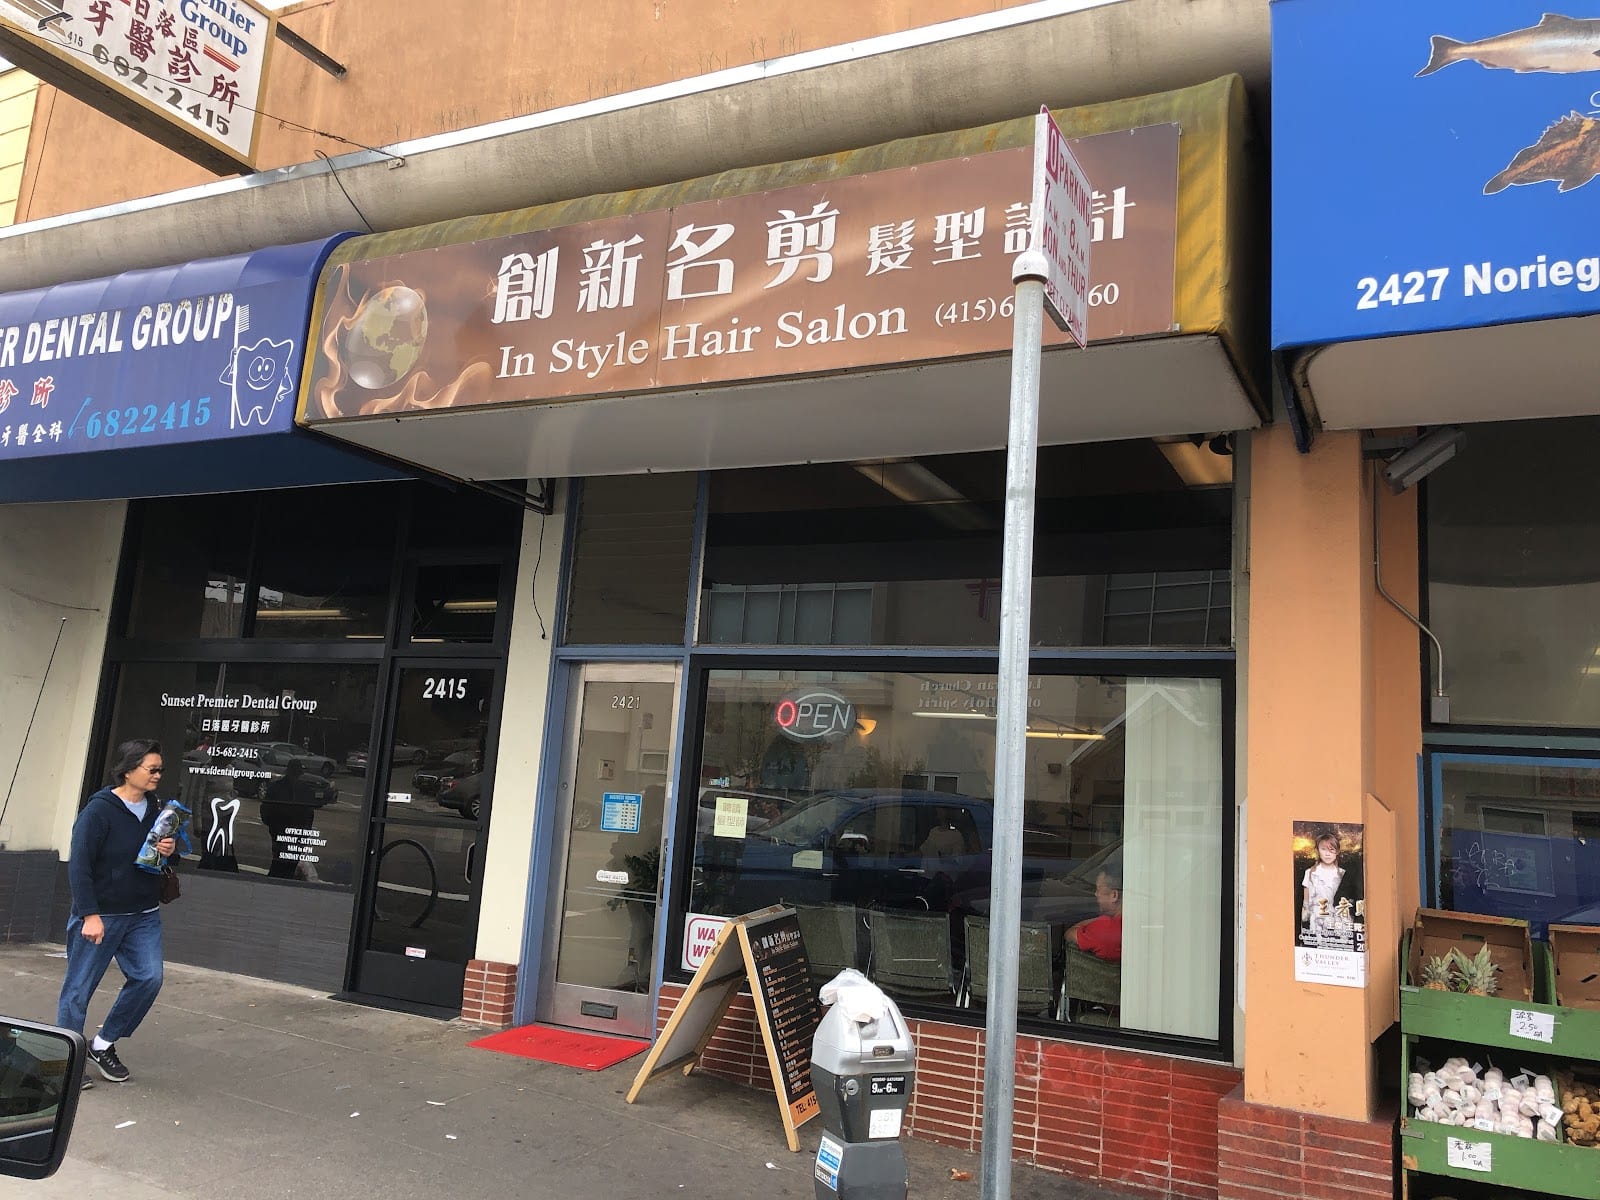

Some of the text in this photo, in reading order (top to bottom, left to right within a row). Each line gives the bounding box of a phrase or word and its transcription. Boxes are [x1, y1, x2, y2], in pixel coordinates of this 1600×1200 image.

[180, 0, 248, 58] Group
[202, 0, 255, 35] mier
[67, 31, 230, 136] 415 682-2415
[1060, 151, 1090, 229] PARKING
[490, 200, 841, 325] 創新名剪
[1068, 255, 1086, 303] THUR
[1356, 254, 1600, 311] 2427 Norieg
[22, 310, 124, 364] DENTAL
[131, 292, 234, 351] GROUP
[496, 345, 536, 379] In
[548, 336, 650, 380] Style
[662, 317, 762, 362] Hair
[775, 302, 909, 350] Salon
[86, 396, 211, 439] 6822415
[160, 692, 318, 714] Sunset Premier Dental Group
[422, 677, 468, 699] 2415
[611, 695, 641, 709] 2421
[776, 701, 851, 730] OPEN
[188, 765, 272, 780] www.sfdentalgroup.com
[206, 746, 259, 760] 415-682-2415
[276, 834, 299, 844] MONDAY
[300, 837, 328, 847] SATURDAY
[279, 852, 320, 863] SUNDAY CLOSED
